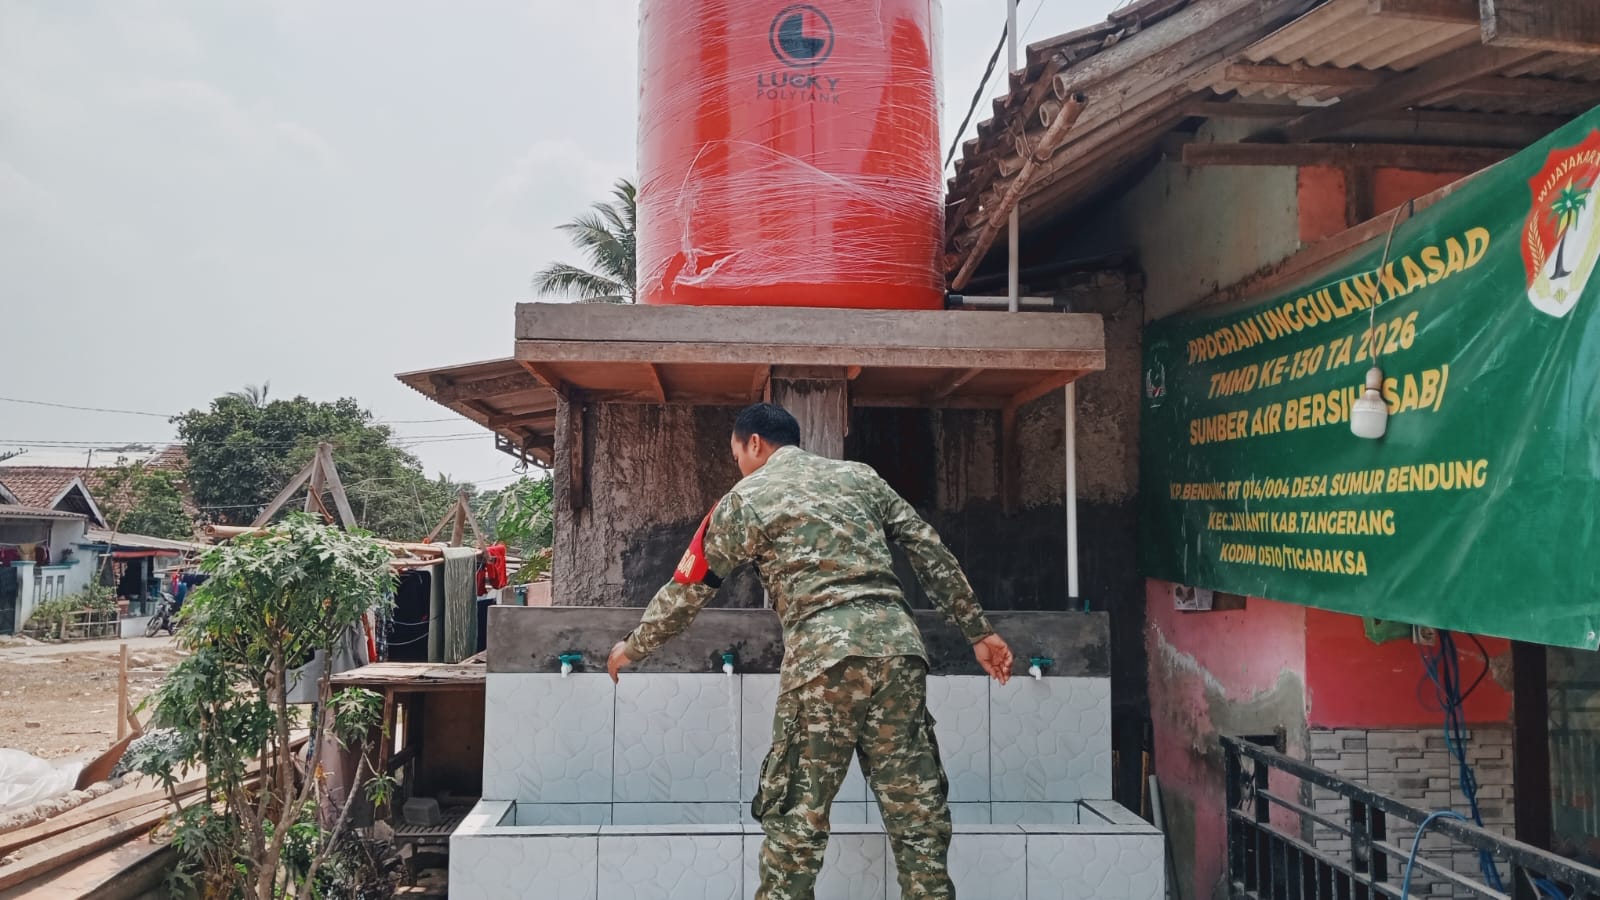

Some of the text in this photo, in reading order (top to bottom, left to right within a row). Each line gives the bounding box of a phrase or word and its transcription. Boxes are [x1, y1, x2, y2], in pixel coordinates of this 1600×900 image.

[757, 72, 838, 90] LUCKY
[757, 89, 840, 104] POLYTANK
[1187, 226, 1490, 365] PROGRAM UNGGULAN KASAD
[1207, 310, 1419, 400] TMMD KE-130 TA 2026
[1189, 409, 1249, 446] SUMBER
[1250, 402, 1282, 437] AIR
[1226, 480, 1241, 501] RT
[1290, 475, 1328, 498] DESA
[1329, 469, 1385, 497] SUMUR
[1386, 458, 1489, 493] BENDUNG
[1219, 543, 1368, 577] KODIM 0510/TIGARAKSA
